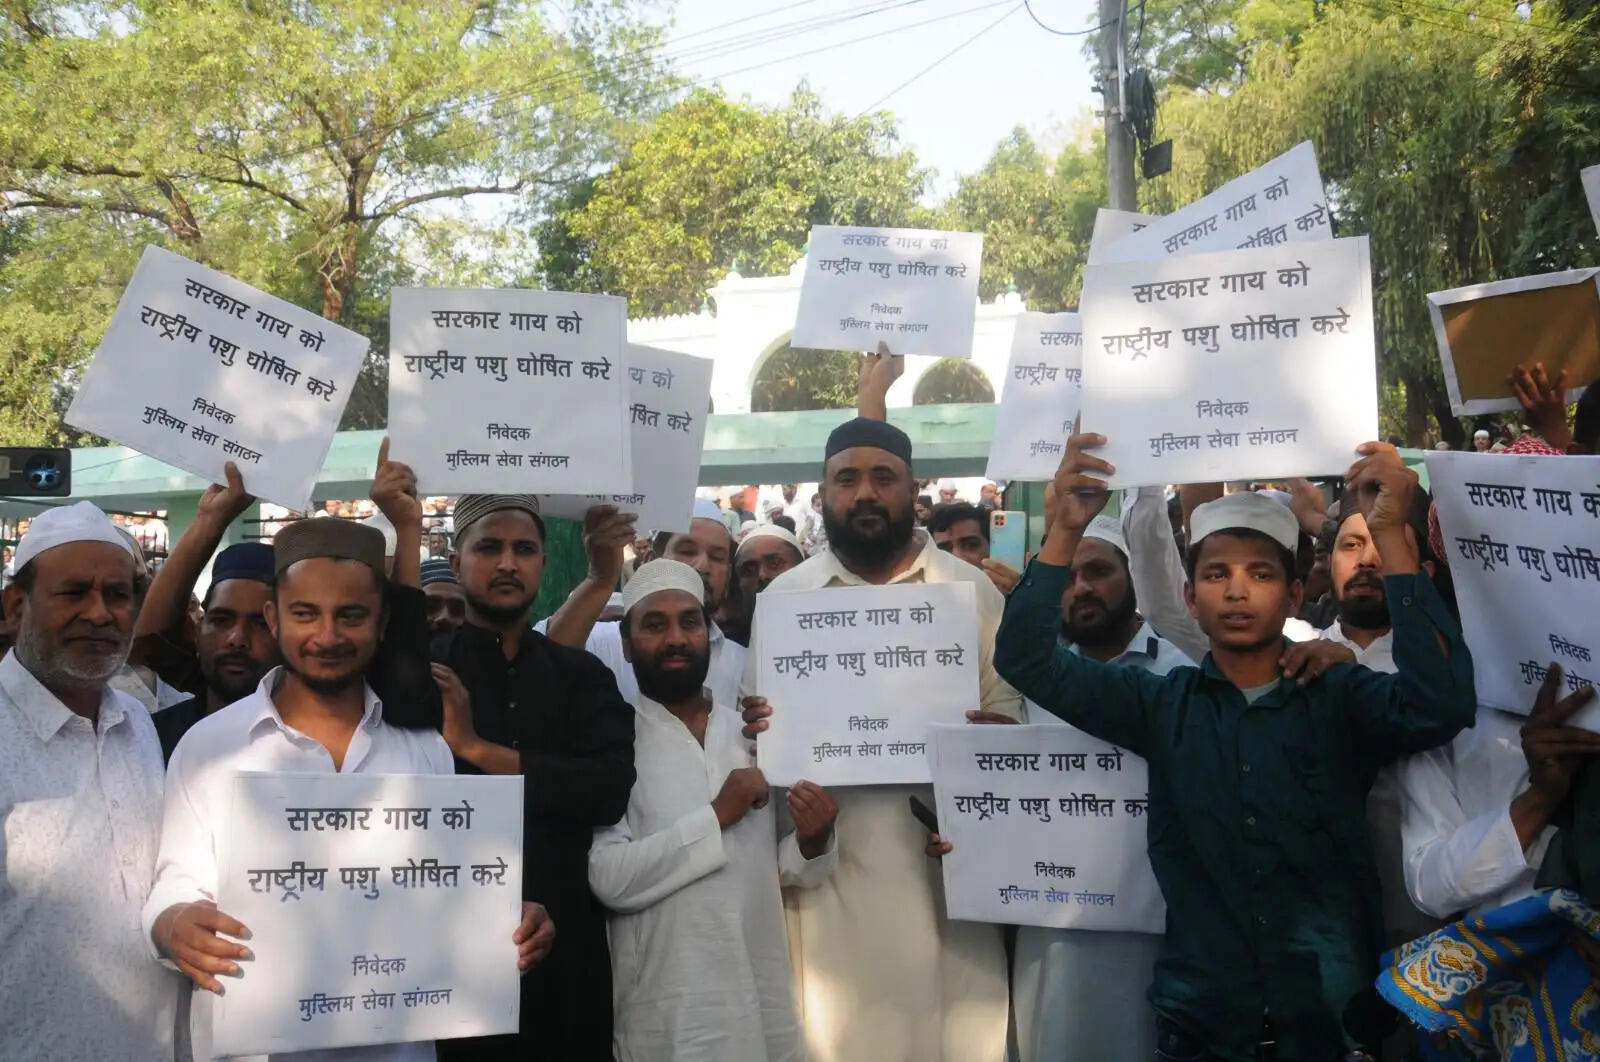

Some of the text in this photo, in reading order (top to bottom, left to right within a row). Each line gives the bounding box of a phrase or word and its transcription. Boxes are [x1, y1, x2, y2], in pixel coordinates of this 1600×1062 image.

[1163, 176, 1289, 254] सरकार गाय को
[1295, 203, 1327, 234] करे
[1132, 261, 1310, 303] सरकार गाय को
[185, 277, 326, 352] सरकार गाय को
[432, 310, 583, 335] सरकार गाय को
[1040, 330, 1082, 346] सरका
[1102, 307, 1350, 360] राष्ट्रीय पशु घोषित करे
[140, 304, 337, 402] राष्ट्रीय पशु घोषित करे
[404, 351, 612, 382] राष्ट्रीय पशु घोषित करे
[652, 368, 675, 389] को
[192, 395, 237, 426] निवेदक
[629, 403, 692, 432] षित करे
[1196, 398, 1249, 419] निवेदक
[143, 405, 263, 464] मुस्लिम सेवा संगठन
[487, 423, 531, 441] निवेदक
[1149, 427, 1299, 457] मुस्लिम सेवा संगठन
[446, 450, 569, 470] मुस्लिम सेवा संगठन
[1465, 482, 1527, 510] सरकार
[1533, 488, 1572, 515] गाय
[1455, 534, 1600, 582] राष्ट्रीय पशु घोषि
[796, 602, 935, 630] सरकार गाय को
[774, 644, 964, 679] राष्ट्रीय पशु घोषित करे
[1549, 634, 1592, 663] निवेदक
[848, 716, 889, 731] निवेदक
[813, 741, 926, 762] मुस्लिम सेवा संगठन
[975, 748, 1123, 771] सरकार गाय को
[285, 800, 474, 831] सरकार गाय को
[954, 793, 1010, 820] राष्ट्रीय
[1019, 798, 1050, 822] पशु
[1060, 794, 1115, 817] घोषित
[248, 857, 508, 901] राष्ट्रीय पशु घोषित करे
[1034, 862, 1076, 879] निवेदक
[999, 885, 1115, 906] मुस्लिम सेवा संगठन
[352, 954, 407, 977] निवेदक
[299, 987, 452, 1022] मुस्लिम सेवा संगठन
